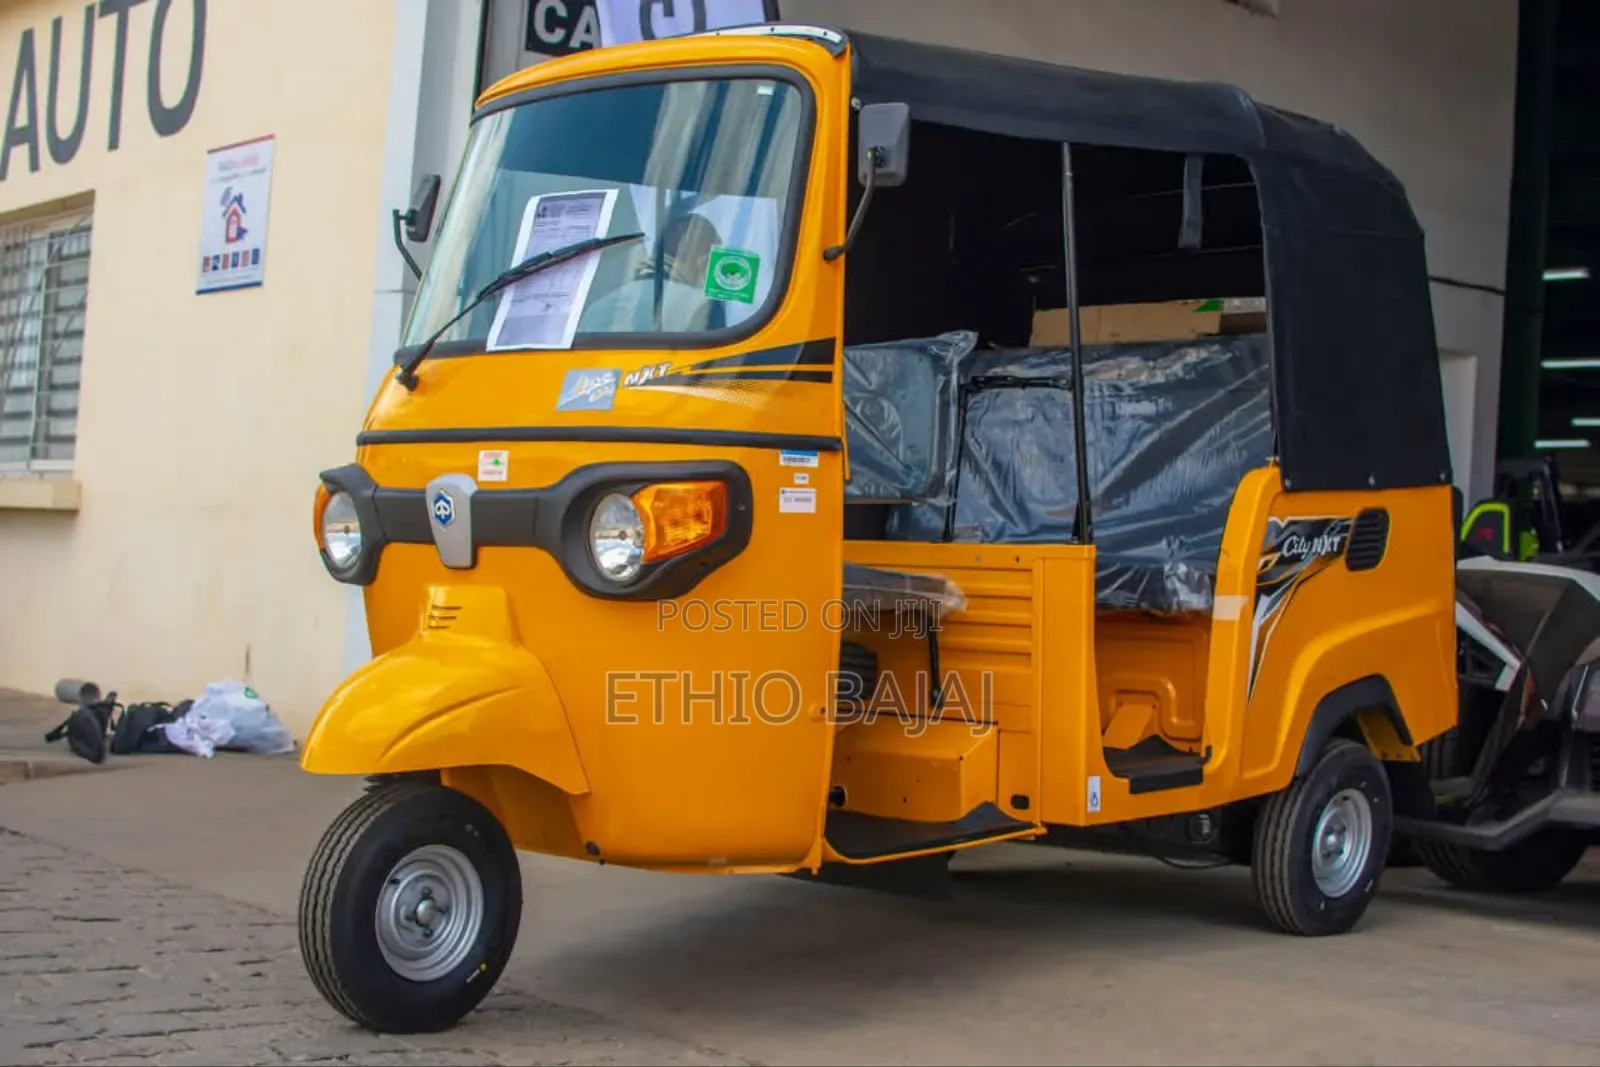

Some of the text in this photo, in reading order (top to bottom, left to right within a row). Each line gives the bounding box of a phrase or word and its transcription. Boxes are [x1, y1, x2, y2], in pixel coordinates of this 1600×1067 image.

[0, 0, 207, 182] AUTO
[623, 362, 671, 386] NXT
[1282, 534, 1341, 559] City NXT
